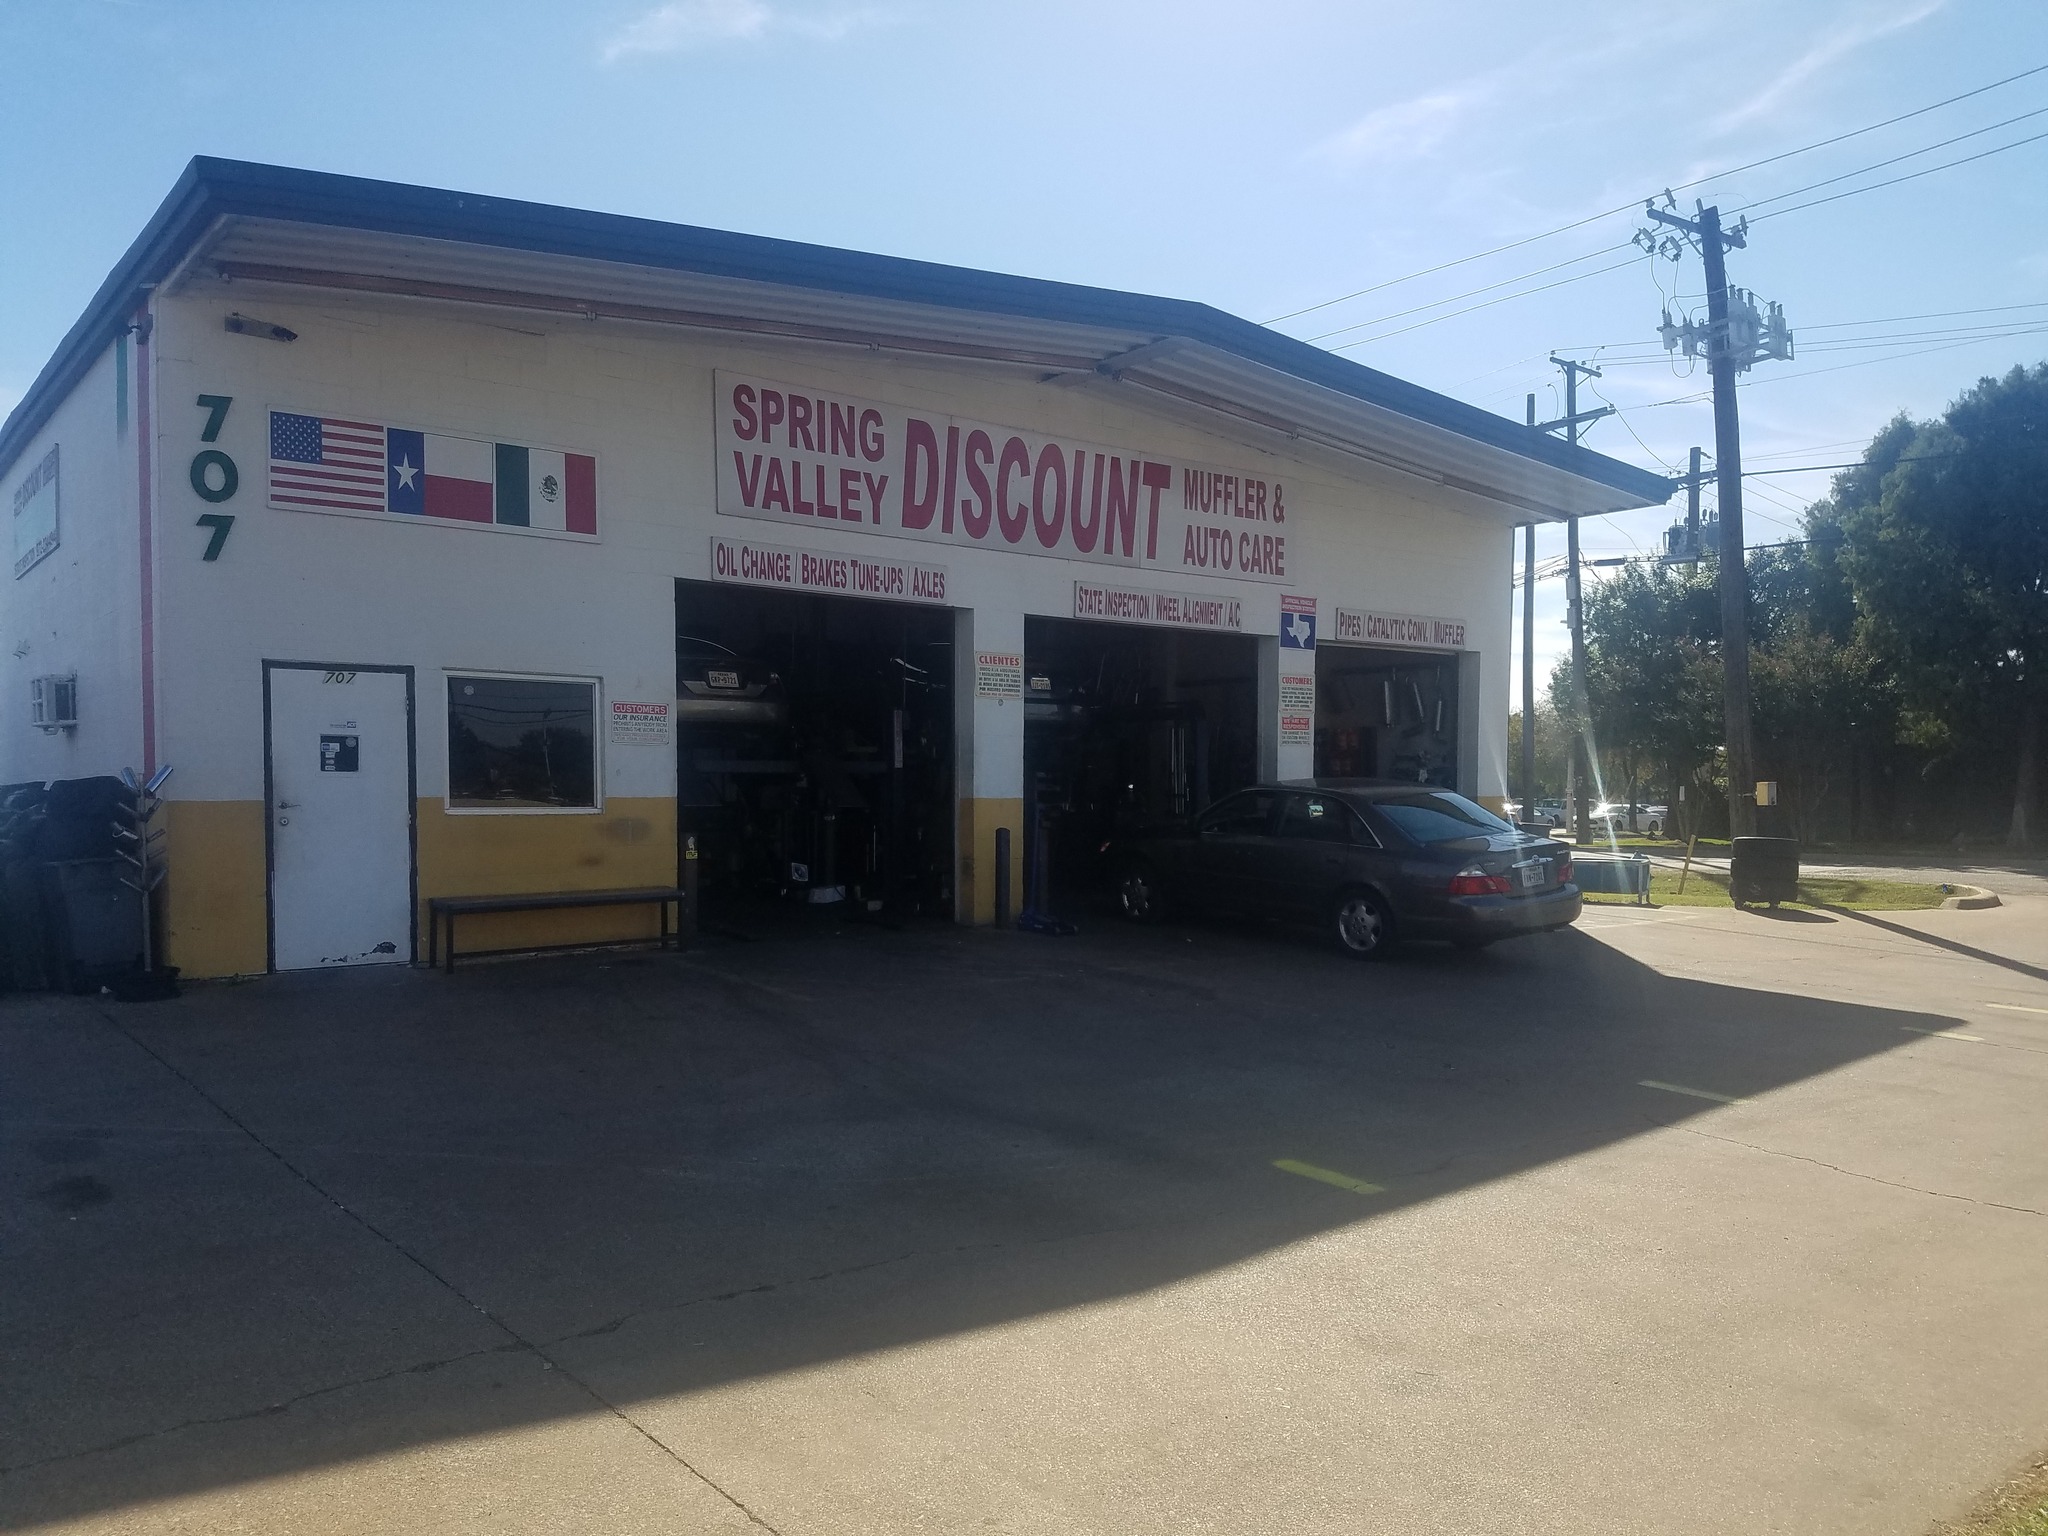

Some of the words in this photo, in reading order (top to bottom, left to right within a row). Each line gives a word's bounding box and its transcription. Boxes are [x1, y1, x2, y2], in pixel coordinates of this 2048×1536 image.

[733, 384, 885, 462] SPRING
[733, 451, 889, 525] VALLEY
[902, 418, 1171, 560] DISCOUNT
[1184, 468, 1267, 521] MUFFLER
[1273, 483, 1285, 524] &
[717, 542, 738, 577] OIL
[741, 545, 791, 583] CHANGE
[802, 553, 847, 589] BRAKES
[850, 560, 904, 595] TUNE-UPS
[913, 567, 945, 599] AXLES
[1183, 524, 1233, 571] AUTO
[1239, 533, 1285, 577] CARE
[1078, 586, 1103, 615] STATE
[1105, 589, 1150, 619] INSPECTION
[1155, 594, 1181, 622] WHEEL
[1183, 597, 1224, 626] ALIGNMENT
[1340, 612, 1361, 637] PIPES
[1367, 615, 1406, 641] CATALYTIC
[1434, 621, 1465, 646] MUFFLER
[325, 672, 357, 684] 707
[979, 655, 1020, 666] CLIENTES
[1282, 676, 1313, 685] CUSTOMERS
[614, 704, 666, 714] CUSTOMERS
